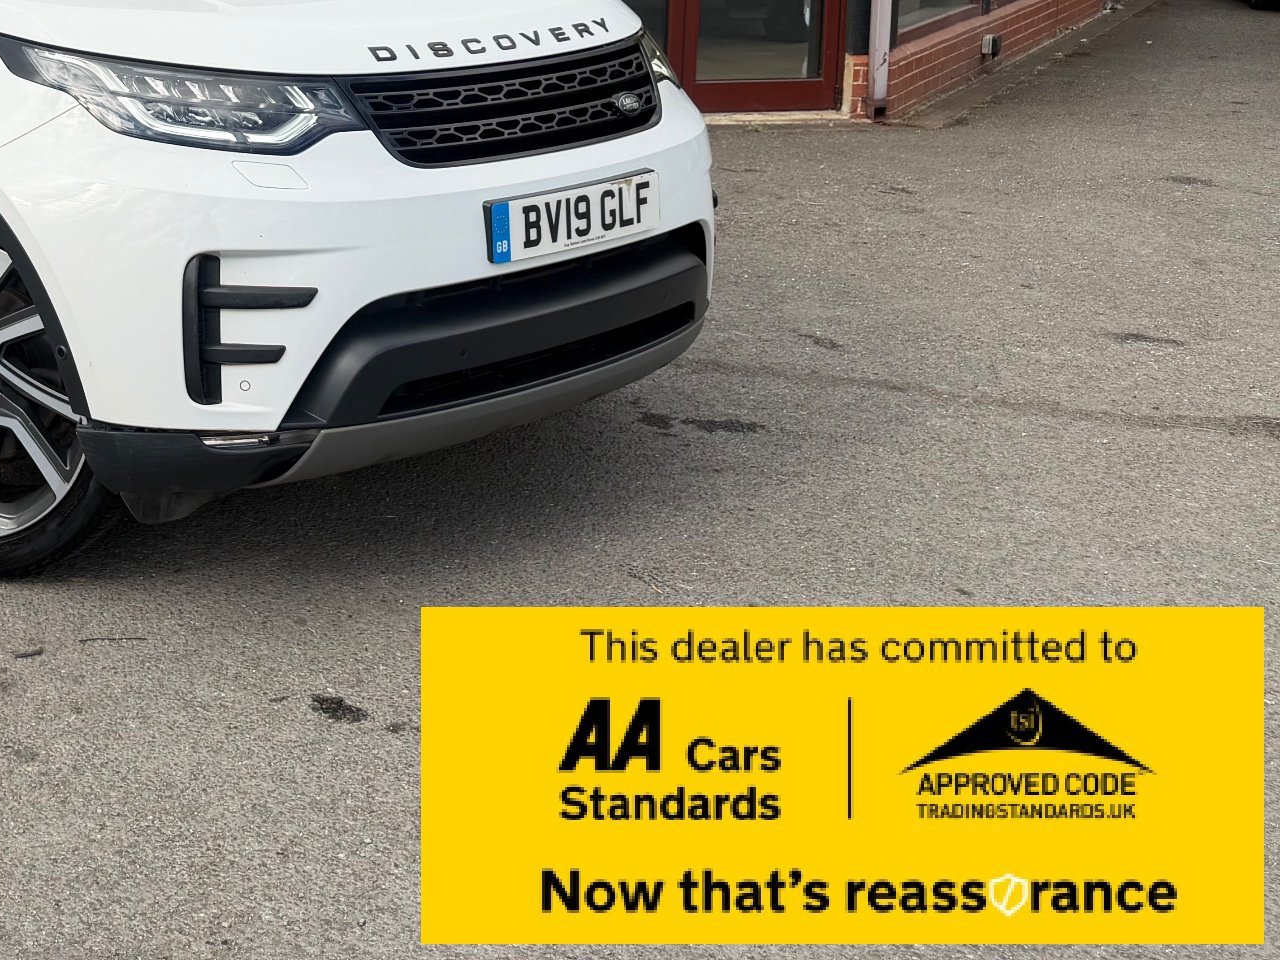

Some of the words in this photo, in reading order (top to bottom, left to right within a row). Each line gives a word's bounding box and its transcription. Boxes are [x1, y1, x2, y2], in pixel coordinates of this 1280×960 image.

[367, 17, 610, 62] DISCOVERY
[522, 194, 592, 249] BV19
[600, 180, 650, 232] GLF
[496, 240, 508, 254] GB
